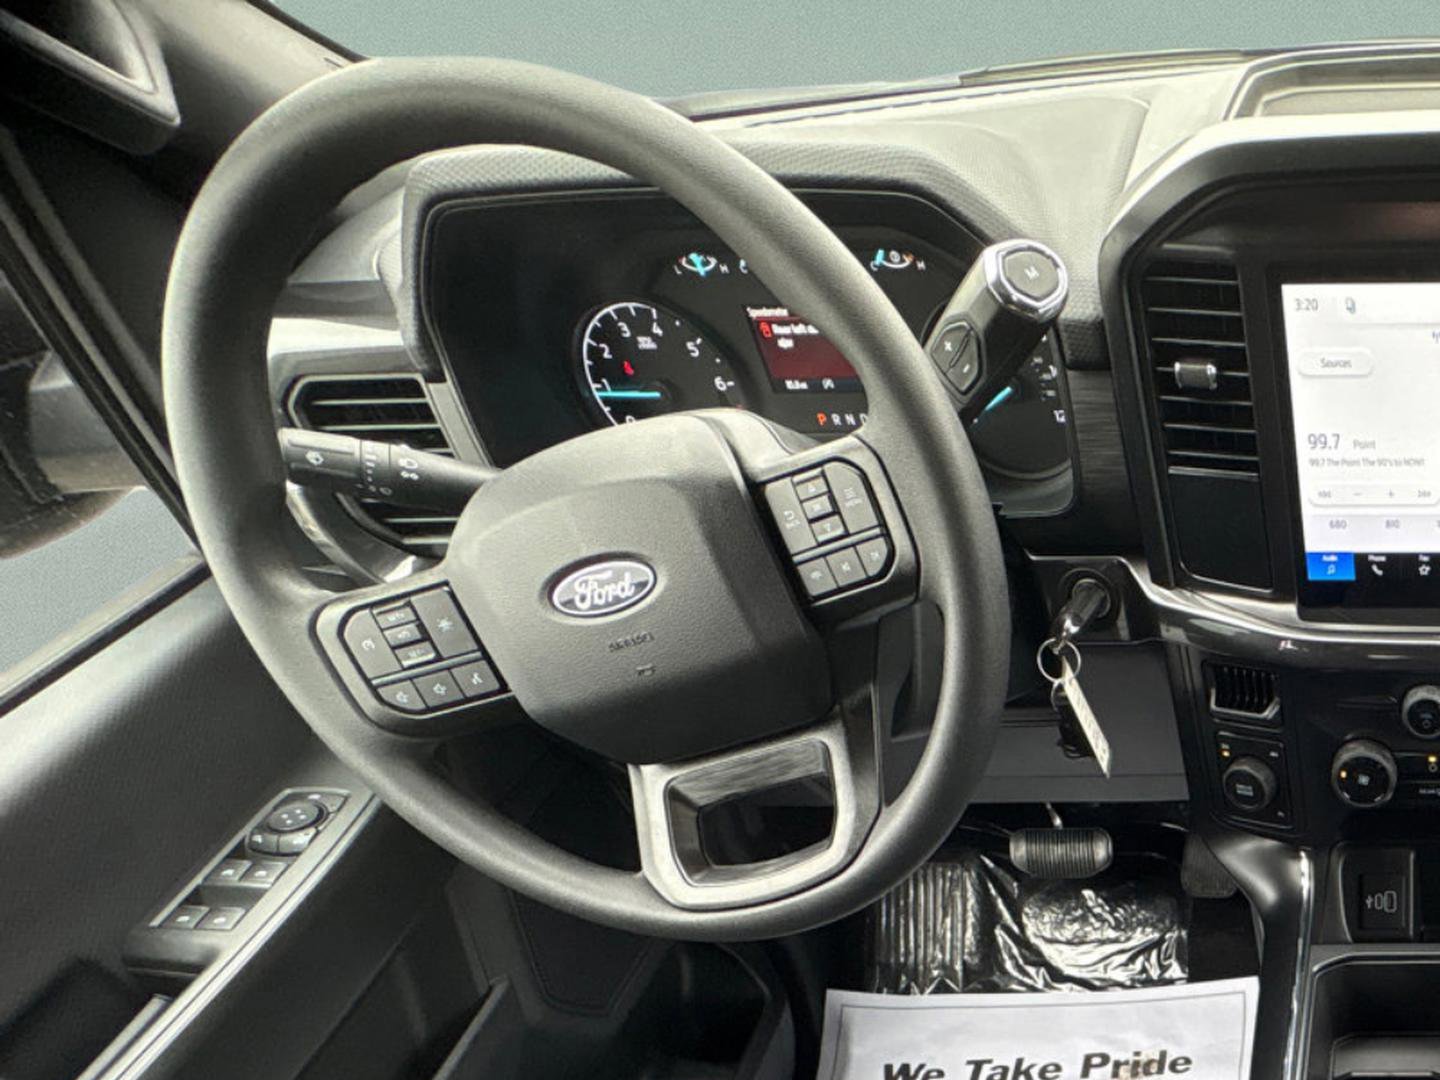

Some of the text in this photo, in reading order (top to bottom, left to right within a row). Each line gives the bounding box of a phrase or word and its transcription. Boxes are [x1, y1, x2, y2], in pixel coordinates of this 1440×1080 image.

[1294, 297, 1319, 311] 3:20
[617, 321, 631, 338] 3
[652, 322, 664, 337] 4
[599, 343, 613, 359] 2
[686, 341, 700, 357] 5
[1319, 357, 1352, 368] Sources
[714, 375, 727, 391] 6
[816, 412, 827, 426] P
[831, 413, 842, 426] R
[844, 413, 856, 426] N
[1307, 433, 1376, 450] 99.7 Point
[1368, 554, 1386, 562] Phone
[574, 569, 635, 610] Ford
[1079, 1050, 1193, 1080] Pride
